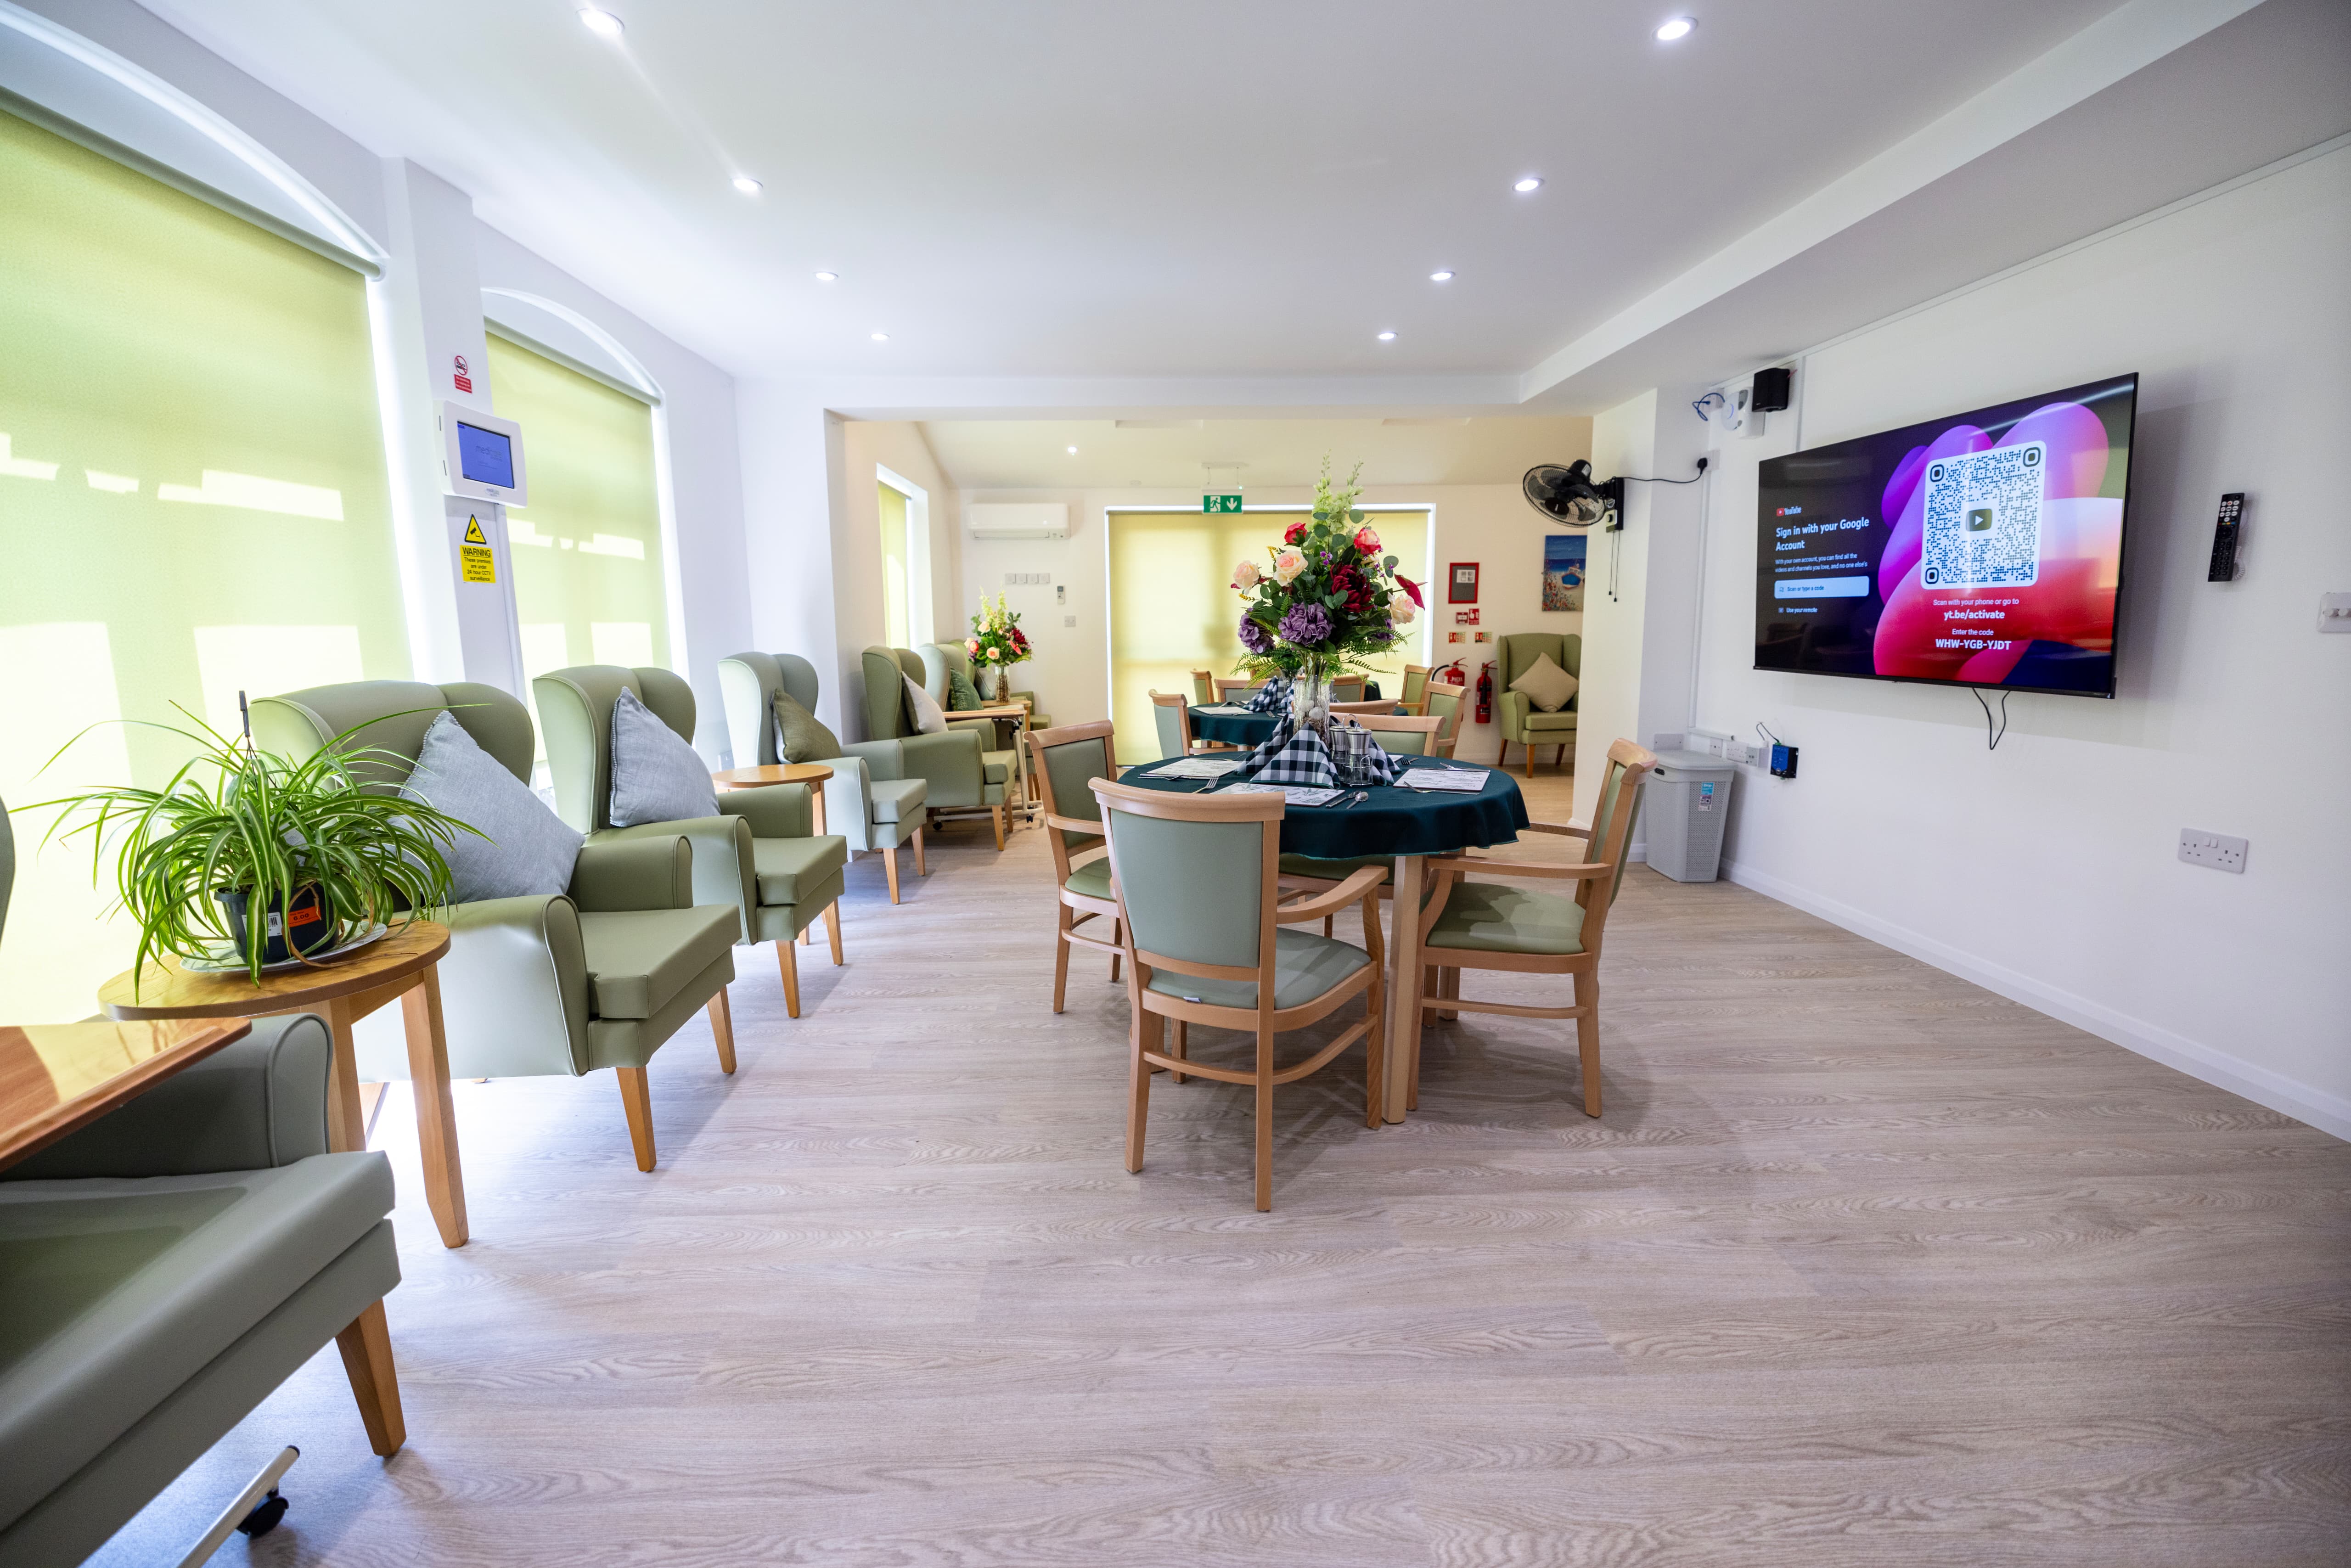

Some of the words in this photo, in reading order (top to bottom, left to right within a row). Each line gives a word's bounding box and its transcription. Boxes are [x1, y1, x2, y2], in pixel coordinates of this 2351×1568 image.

[1784, 506, 1802, 515] YouTube
[1776, 527, 1792, 539] Sign
[1793, 526, 1800, 535] in
[1802, 523, 1818, 534] with
[1820, 523, 1838, 534] your
[1839, 517, 1870, 530] Google
[1775, 540, 1805, 551] Account
[462, 547, 491, 557] WARNING
[1944, 609, 2005, 621] yt.be/activate
[1935, 639, 2012, 650] WHW-YGB-YJDT
